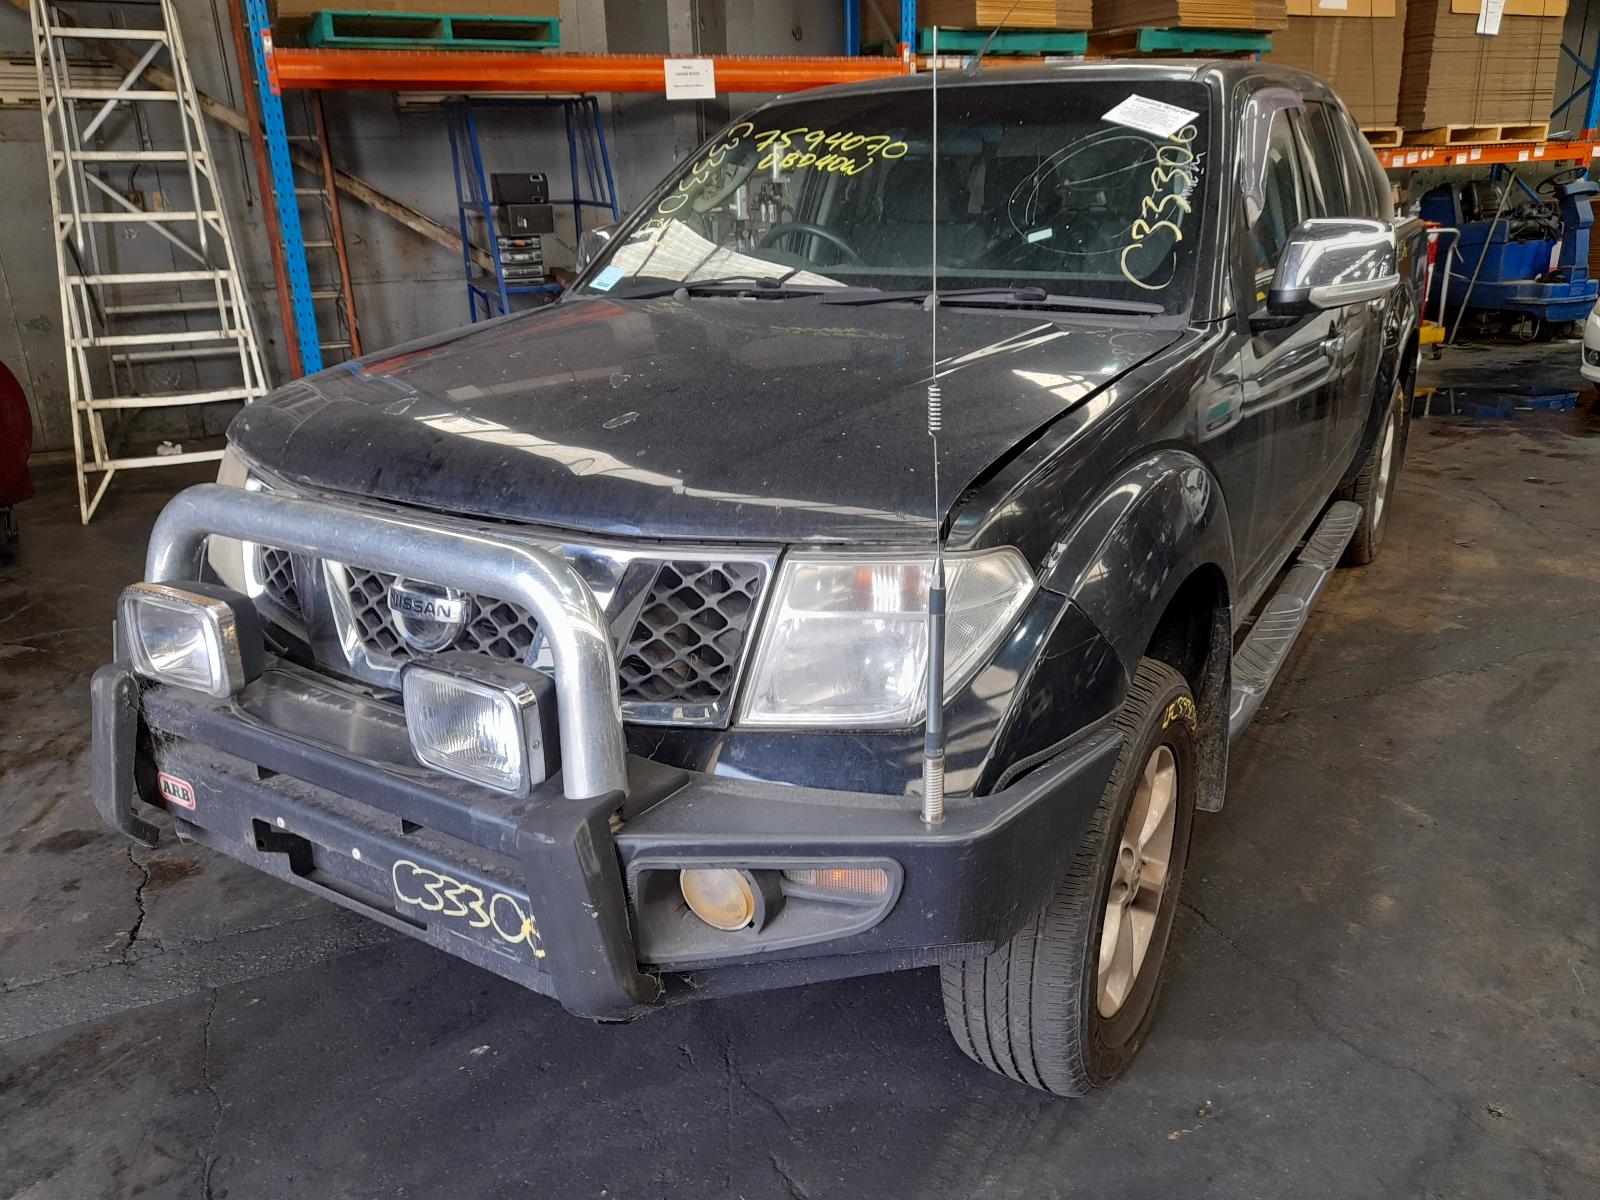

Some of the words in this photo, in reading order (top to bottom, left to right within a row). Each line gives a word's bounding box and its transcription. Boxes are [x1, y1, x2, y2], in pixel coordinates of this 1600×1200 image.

[754, 127, 909, 159] 7594070
[1120, 124, 1198, 290] C33306
[391, 591, 451, 618] NISSAN
[163, 778, 191, 802] ARB
